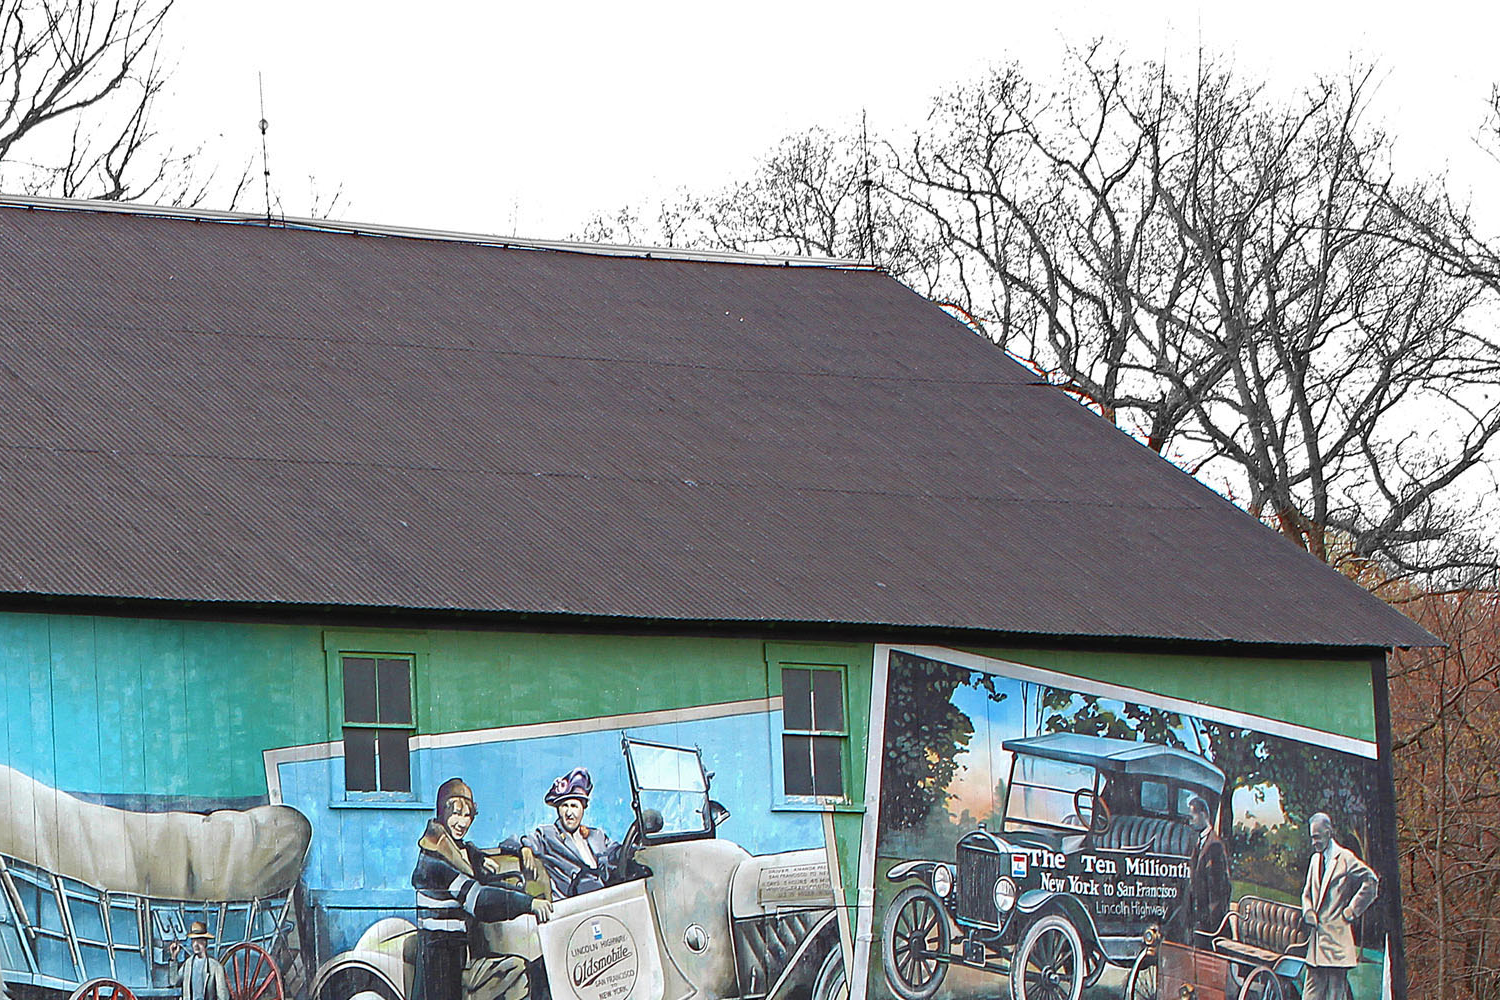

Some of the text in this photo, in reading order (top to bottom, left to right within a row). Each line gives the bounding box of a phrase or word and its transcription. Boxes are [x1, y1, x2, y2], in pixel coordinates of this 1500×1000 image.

[1027, 850, 1191, 879] The Ten Millionth
[1040, 872, 1177, 899] New York to San Francisco
[1096, 902, 1168, 919] Lincoln Highway
[571, 943, 599, 958] LINCOLN
[573, 945, 630, 987] Oldsmobile
